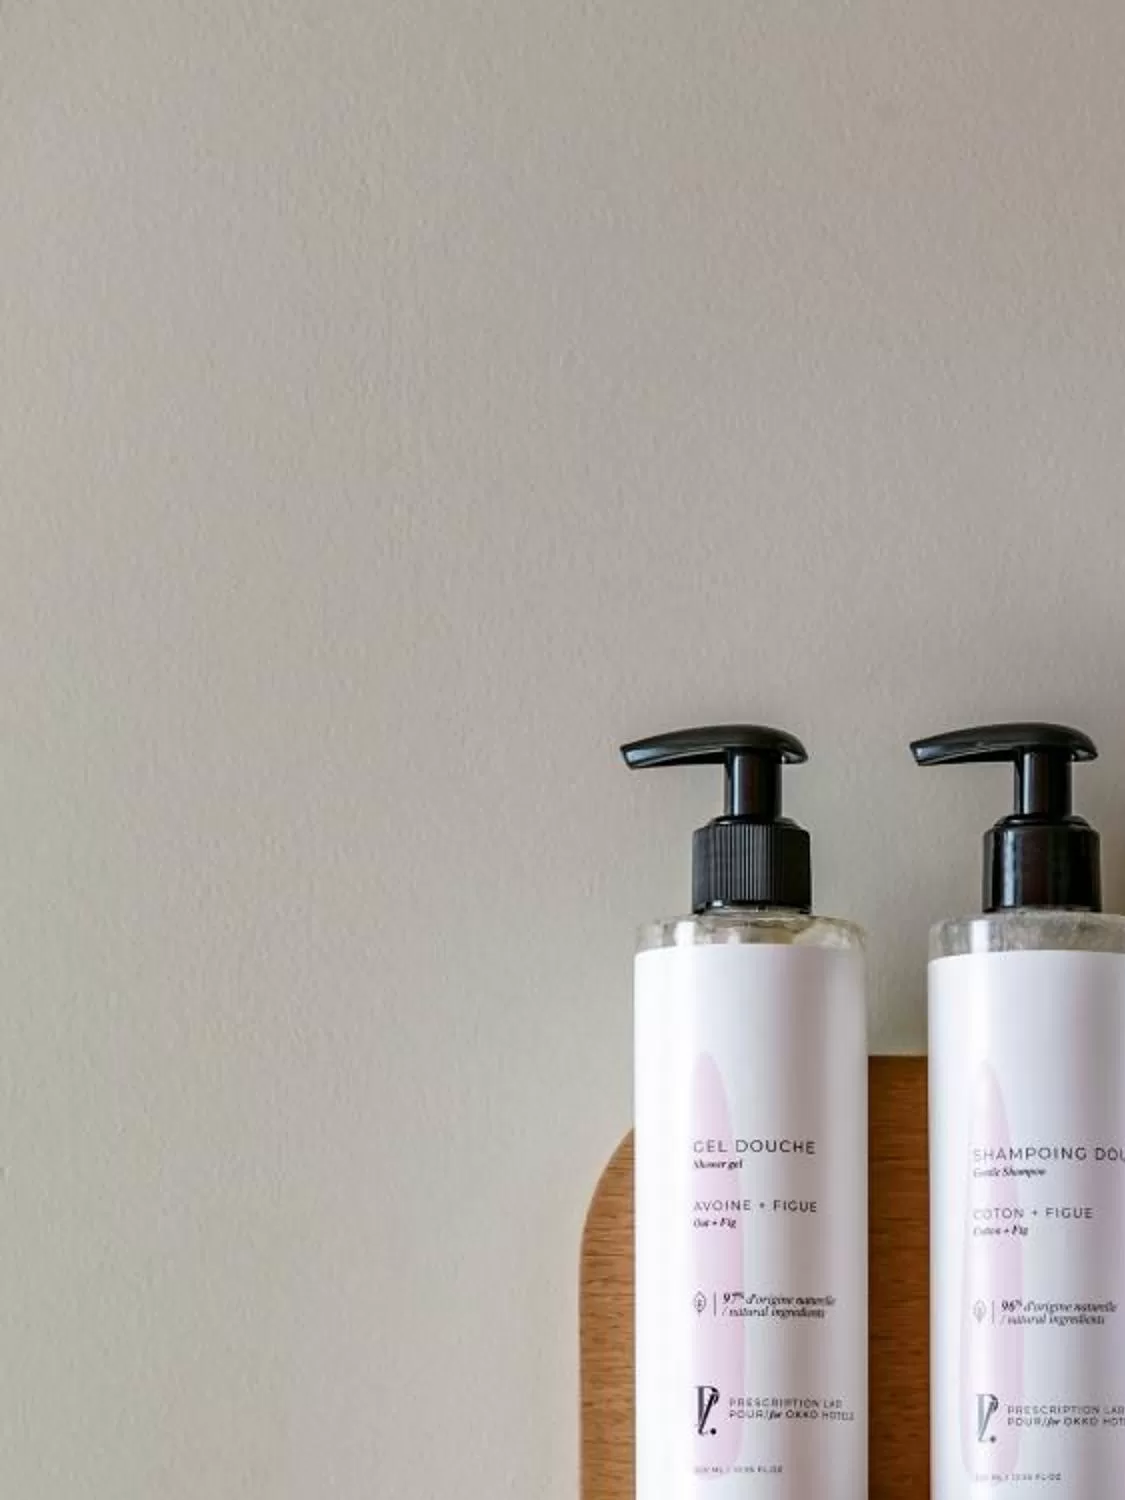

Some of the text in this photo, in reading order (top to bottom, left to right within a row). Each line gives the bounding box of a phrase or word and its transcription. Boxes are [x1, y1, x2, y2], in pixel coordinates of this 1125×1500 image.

[693, 1139, 817, 1155] GEL DOUCHE
[973, 1147, 1087, 1162] SHAMPOING
[727, 1159, 743, 1171] gel
[693, 1199, 751, 1212] AVOINE
[773, 1200, 817, 1213] FIGUE
[973, 1207, 1025, 1220] COTON
[1045, 1207, 1093, 1219] FIGUE
[729, 1397, 820, 1409] PRESCRIPTION
[785, 1409, 819, 1419] OKKO
[821, 1411, 855, 1421] HOTELS
[1007, 1404, 1125, 1415] PRESCRIPTION LAB
[1063, 1416, 1099, 1427] OKKO
